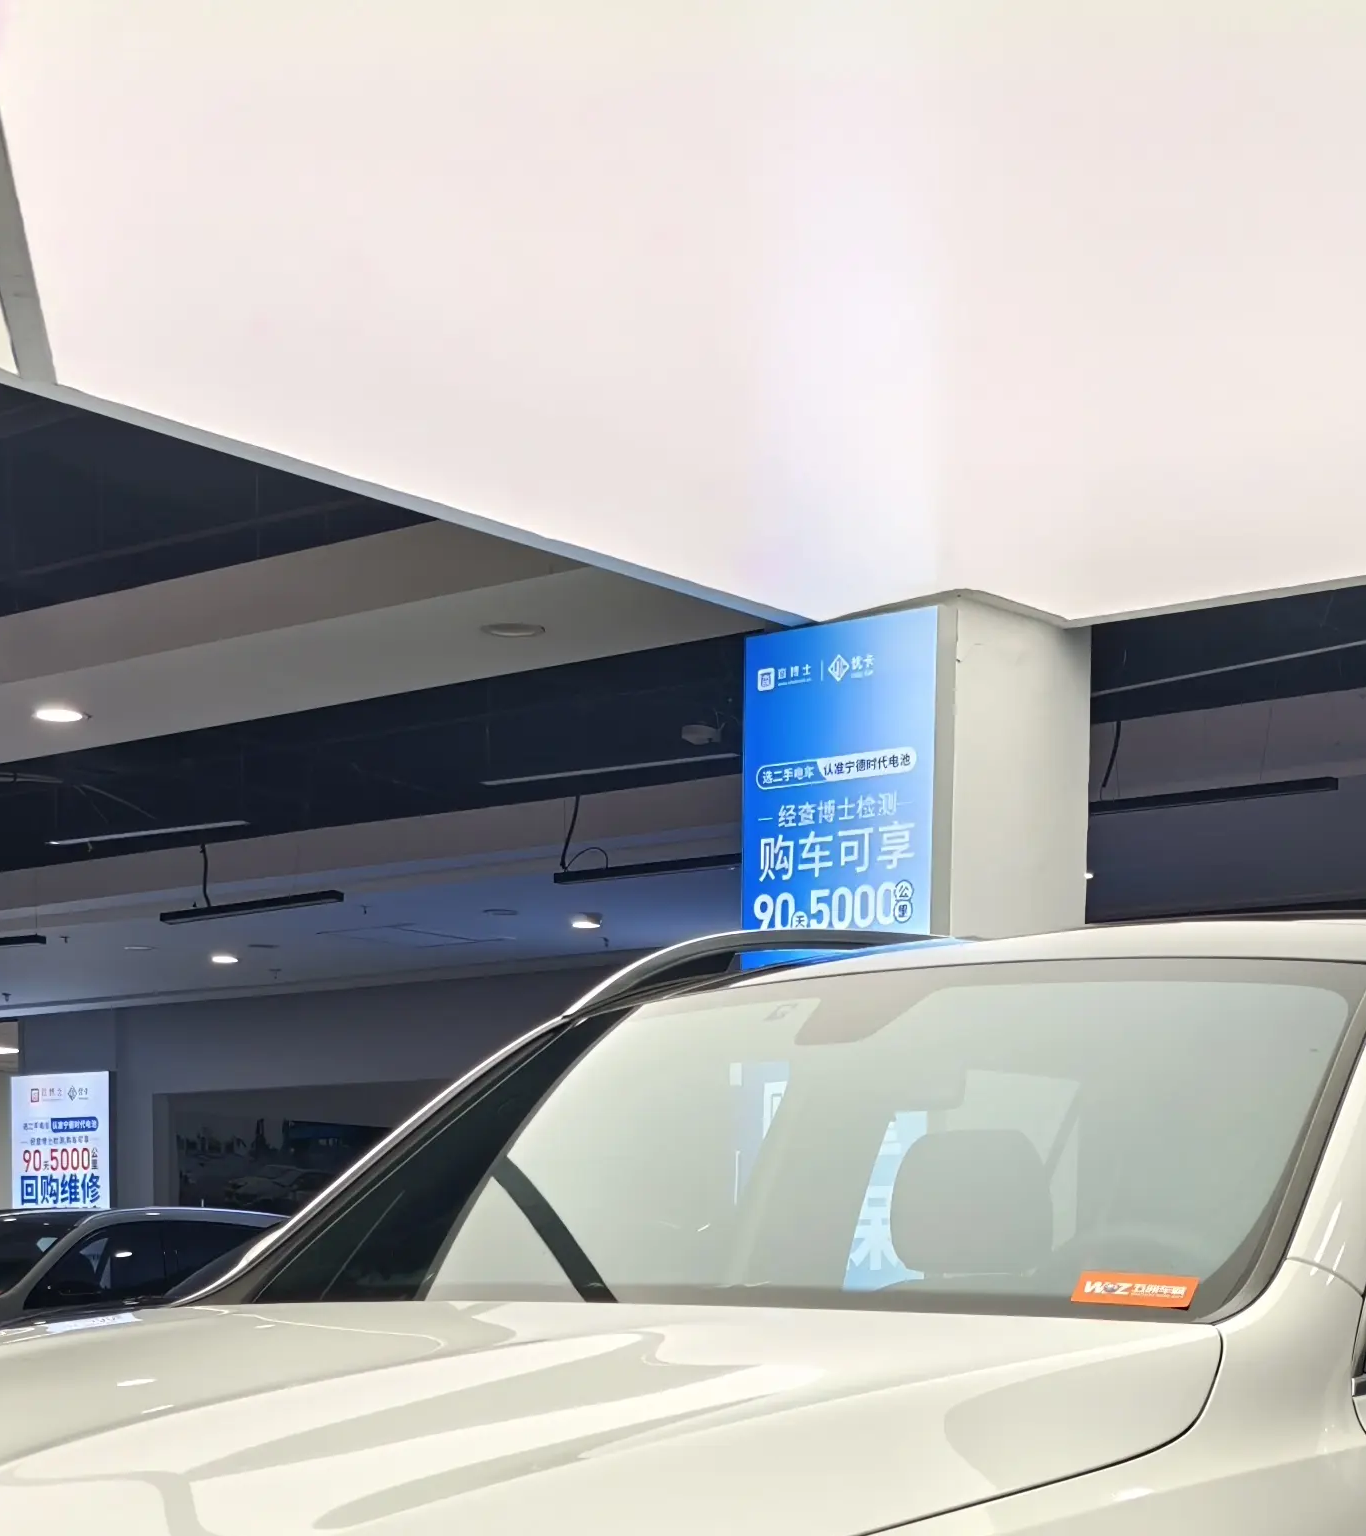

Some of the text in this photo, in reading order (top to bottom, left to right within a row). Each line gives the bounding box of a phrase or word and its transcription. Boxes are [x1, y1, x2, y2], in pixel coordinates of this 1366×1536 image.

[762, 753, 911, 785] 选二手电车 认准宁德时代电池
[778, 791, 897, 828] 经查博士检测
[758, 821, 915, 883] 购车可享
[20, 1173, 101, 1205] 回购维修
